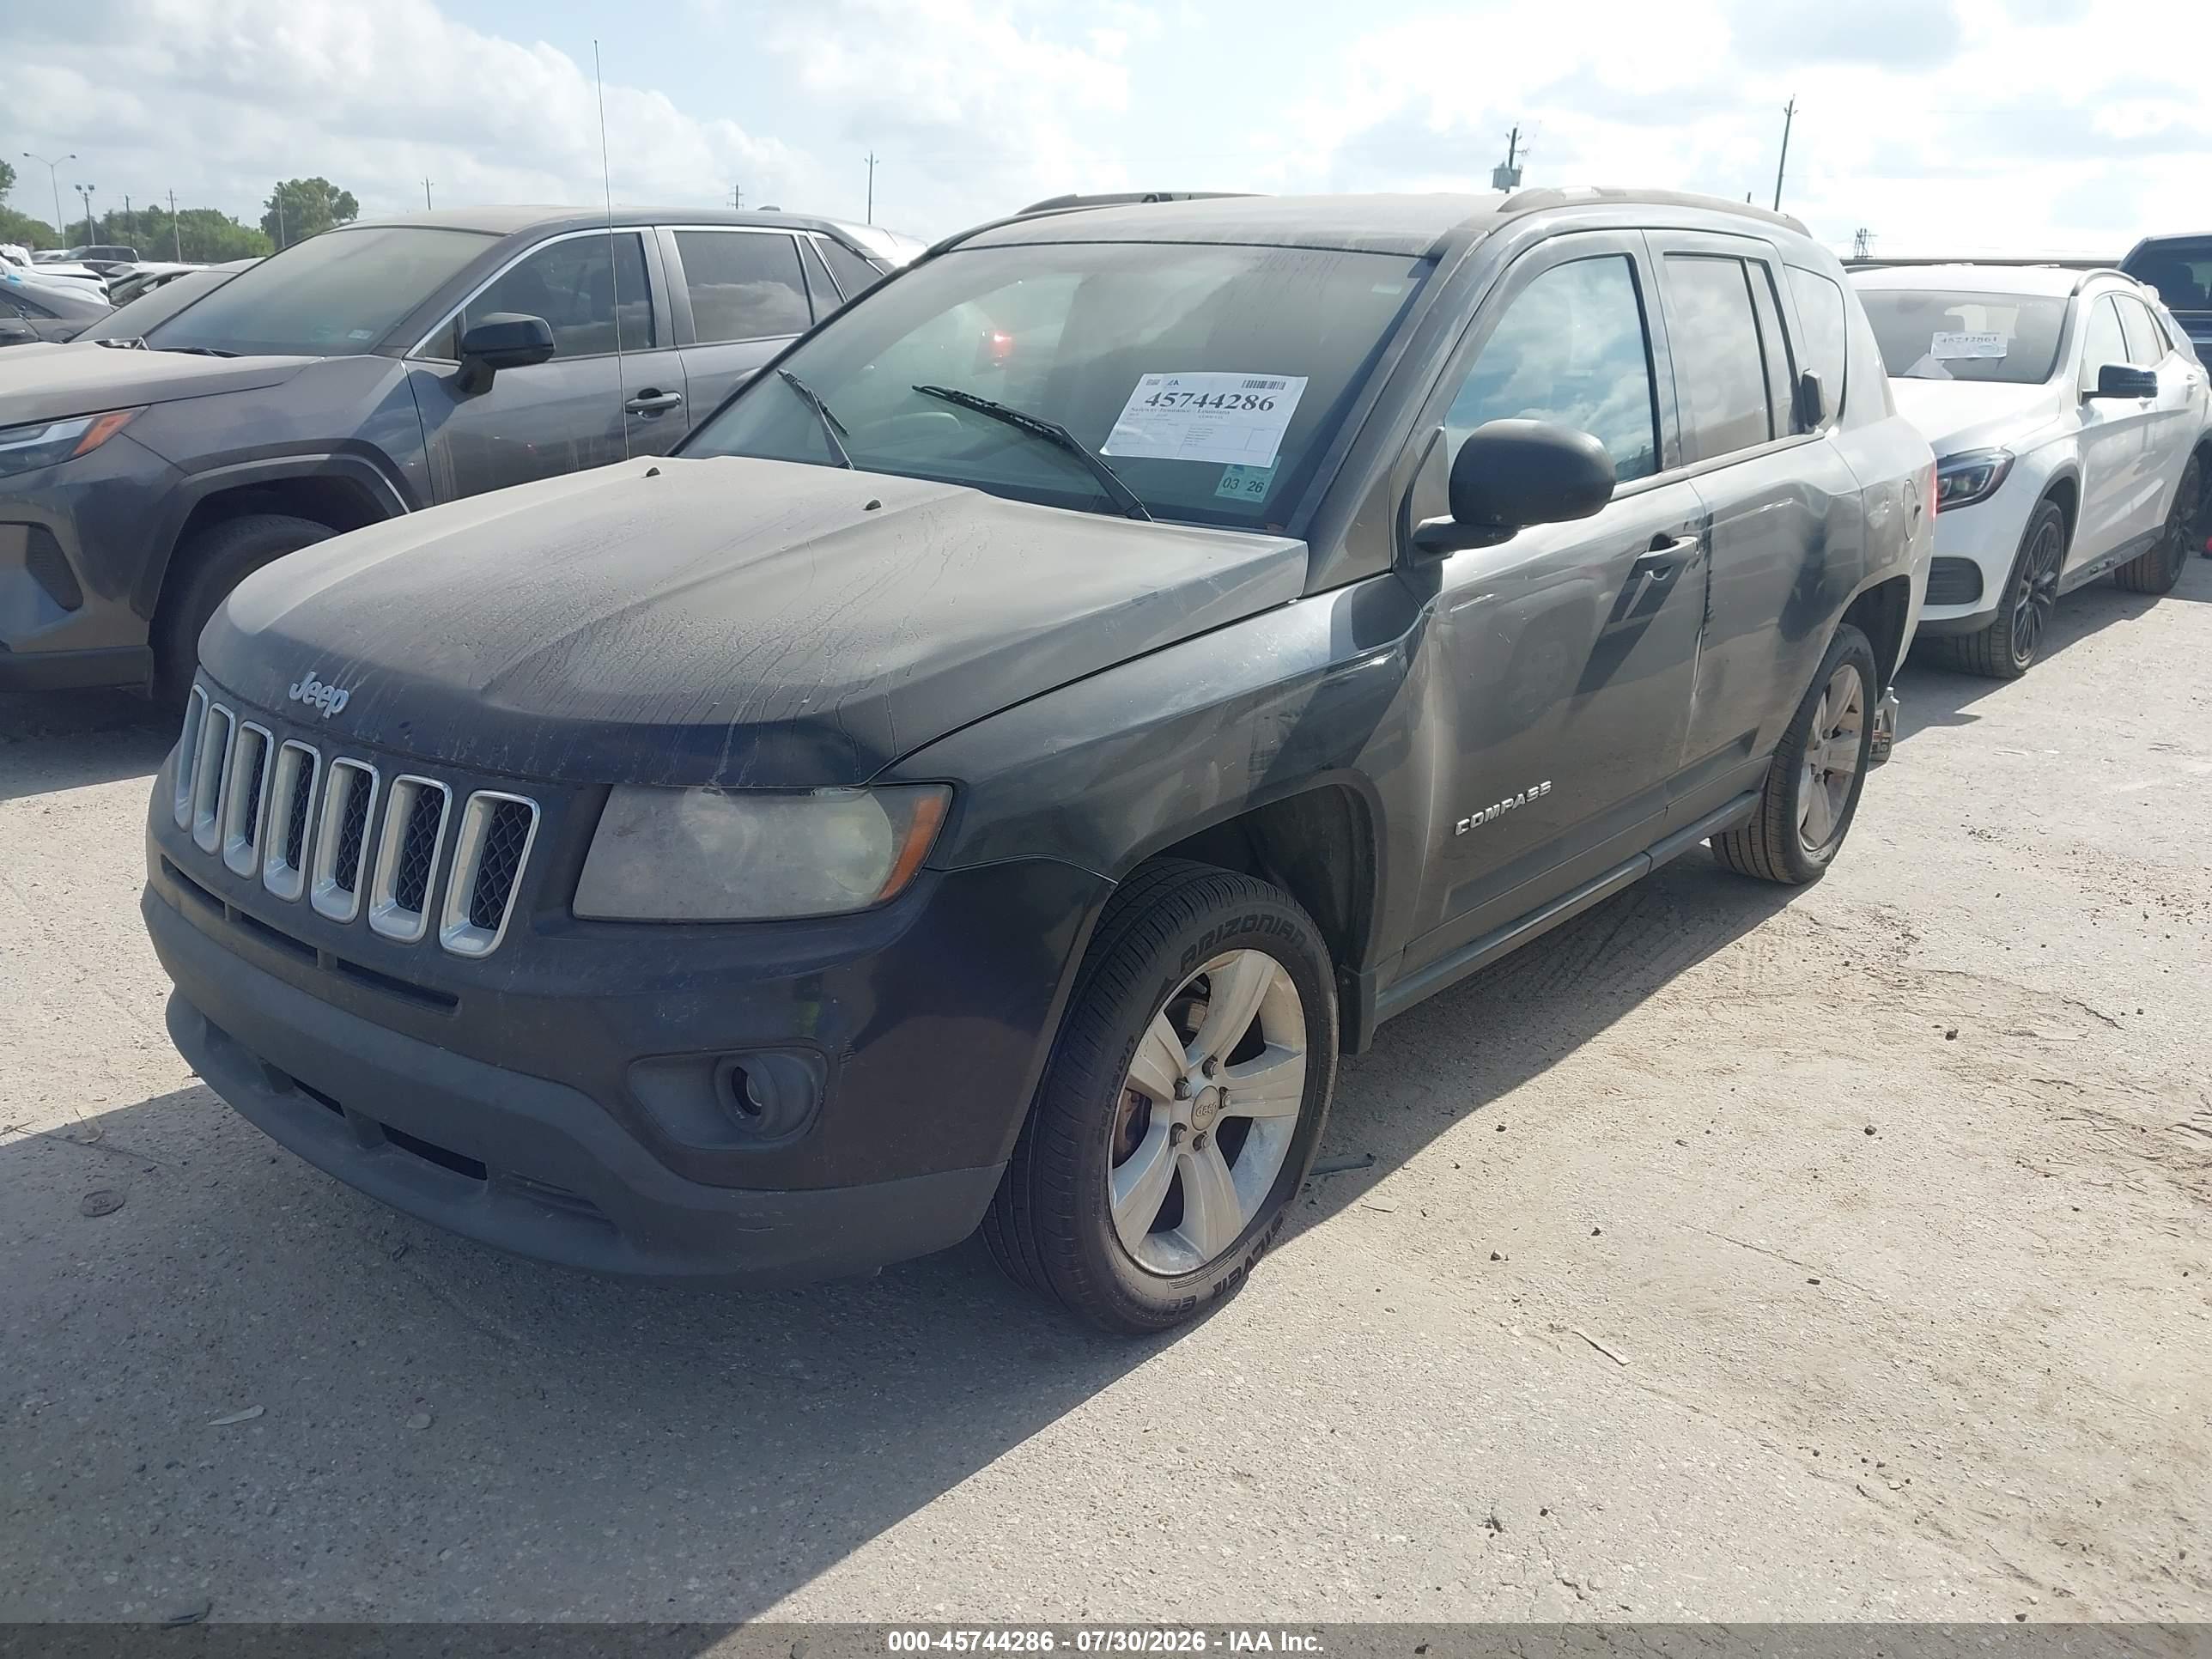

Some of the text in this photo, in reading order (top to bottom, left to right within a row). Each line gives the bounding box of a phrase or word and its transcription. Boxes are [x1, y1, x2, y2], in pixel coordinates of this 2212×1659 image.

[1145, 391, 1278, 412] 45744286
[1223, 477, 1265, 493] 03 26
[289, 671, 349, 720] Jeep
[1455, 780, 1553, 836] COMPASS
[1180, 914, 1307, 974] ARIZONIAN
[1213, 1211, 1285, 1297] SILVER
